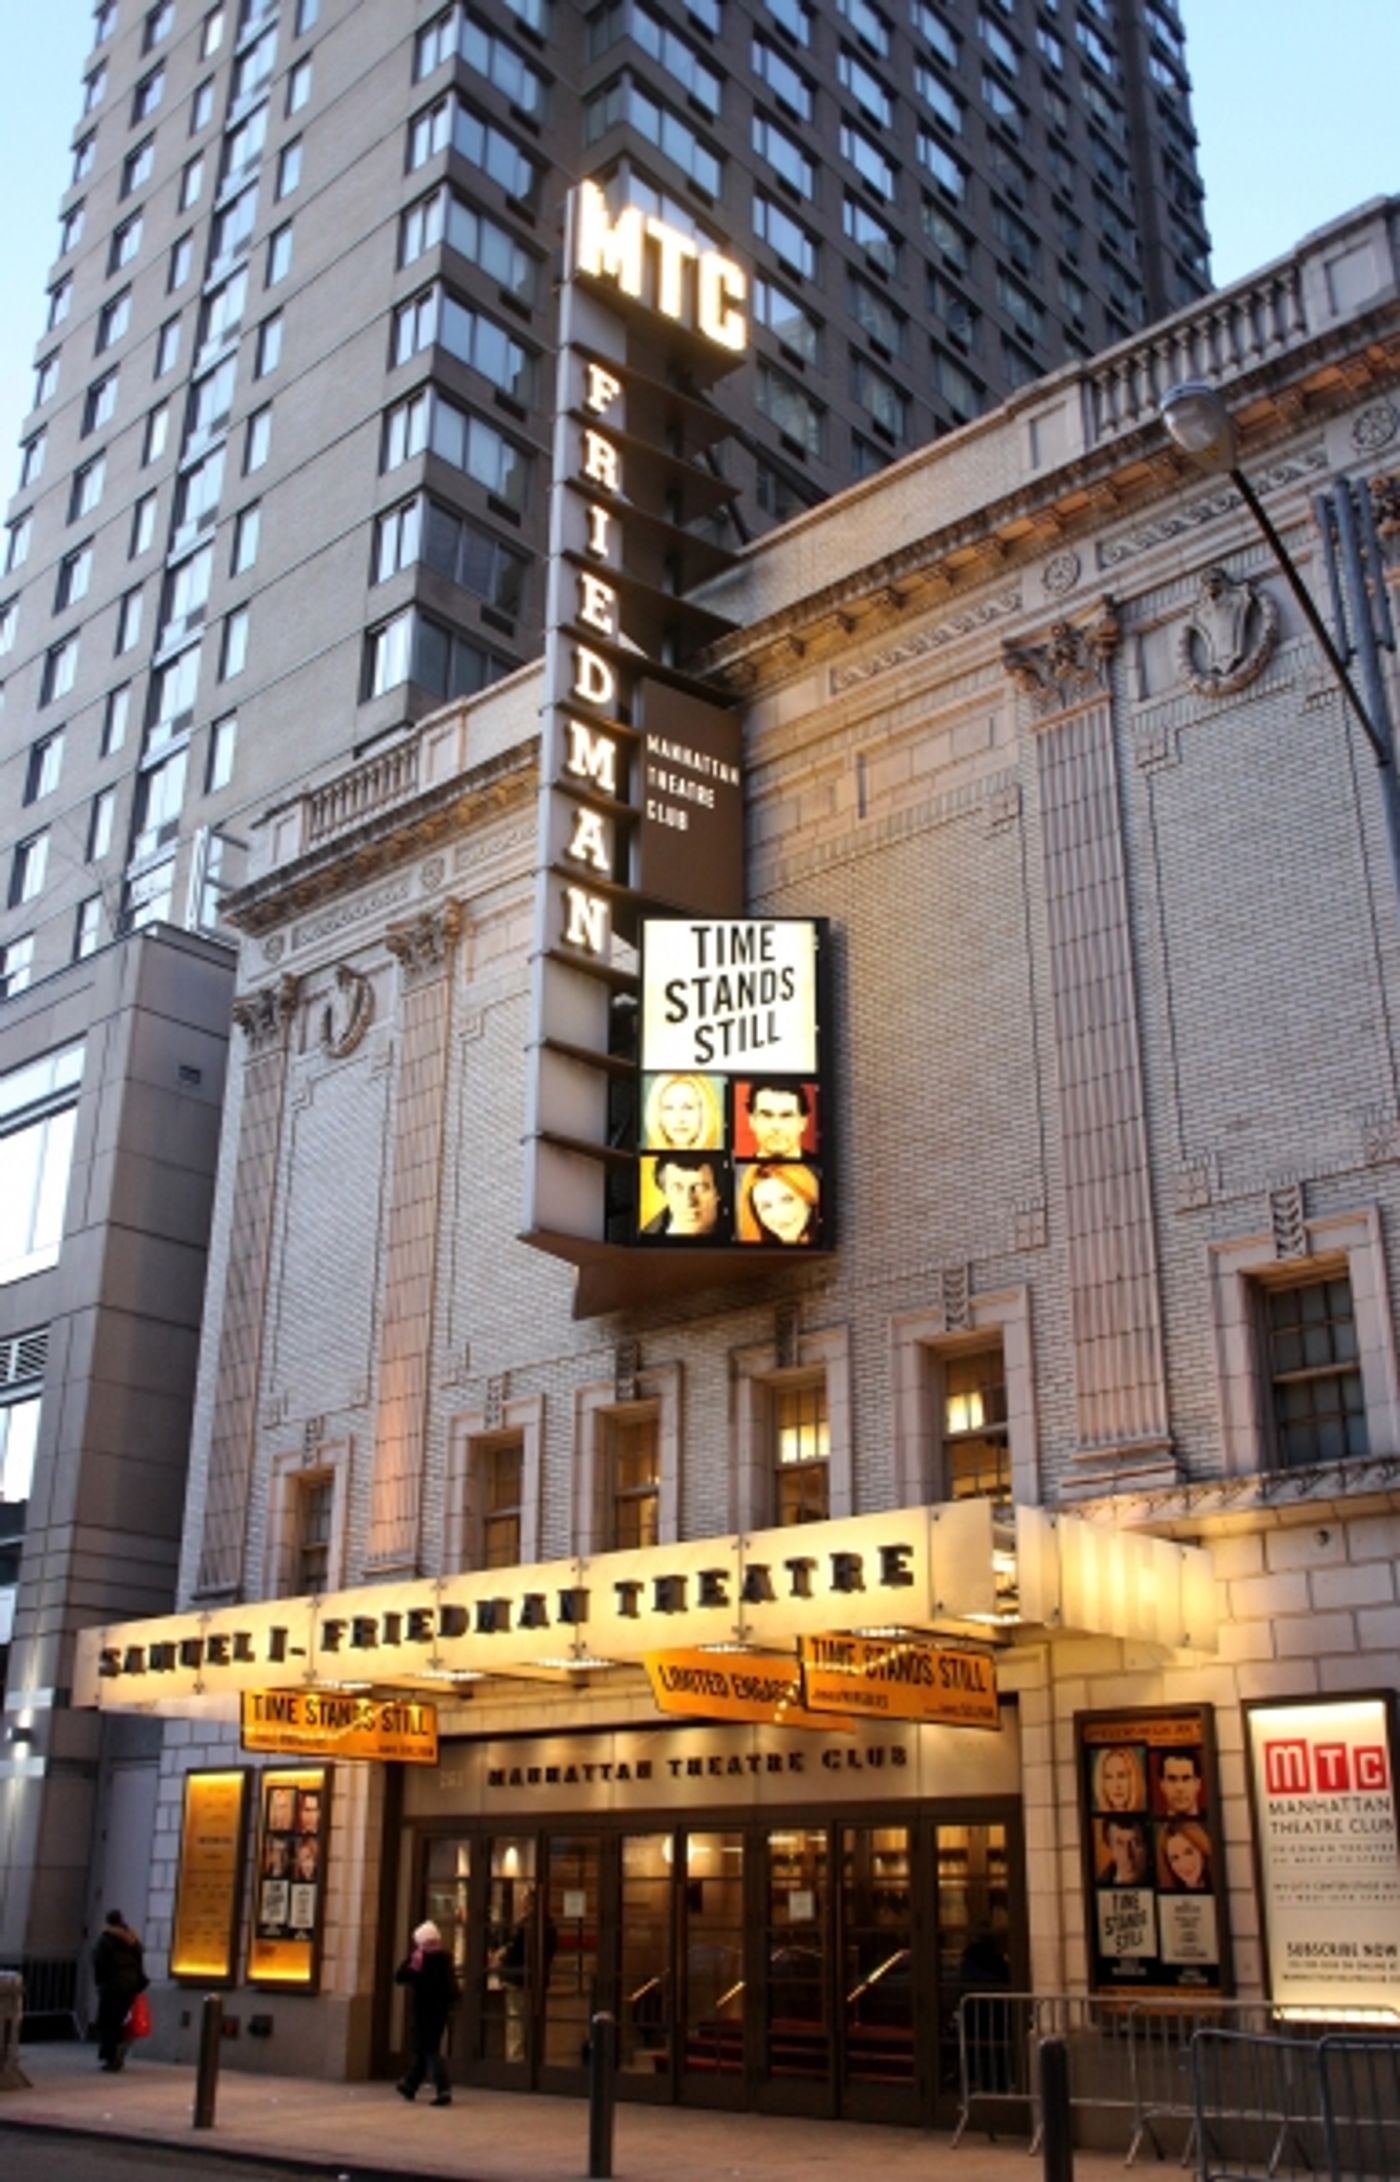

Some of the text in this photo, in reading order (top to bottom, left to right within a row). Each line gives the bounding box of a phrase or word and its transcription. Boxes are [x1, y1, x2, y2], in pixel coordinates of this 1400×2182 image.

[579, 178, 746, 351] MTC
[567, 364, 620, 956] FRIEDMAN
[646, 734, 740, 787] MANHATTAN
[647, 766, 715, 810] THEATRE
[647, 799, 689, 831] CLUB
[691, 924, 776, 968] TIME
[665, 966, 795, 1024] STANDS
[694, 1011, 782, 1066] STILL
[99, 1631, 255, 1677] SAMUEL
[320, 1585, 592, 1653] FRIEDMAN
[614, 1542, 916, 1619] THEATRE
[810, 1636, 987, 1692] TIME STANDS STILL
[252, 1694, 431, 1736] TIME STANDS STILL
[488, 1745, 907, 1787] MANHATTAN THEATRE CLUB
[1266, 1741, 1389, 1793] MTC
[1268, 1797, 1391, 1815] MANHATTAN
[1270, 1819, 1395, 1834] THEATRE CLUB
